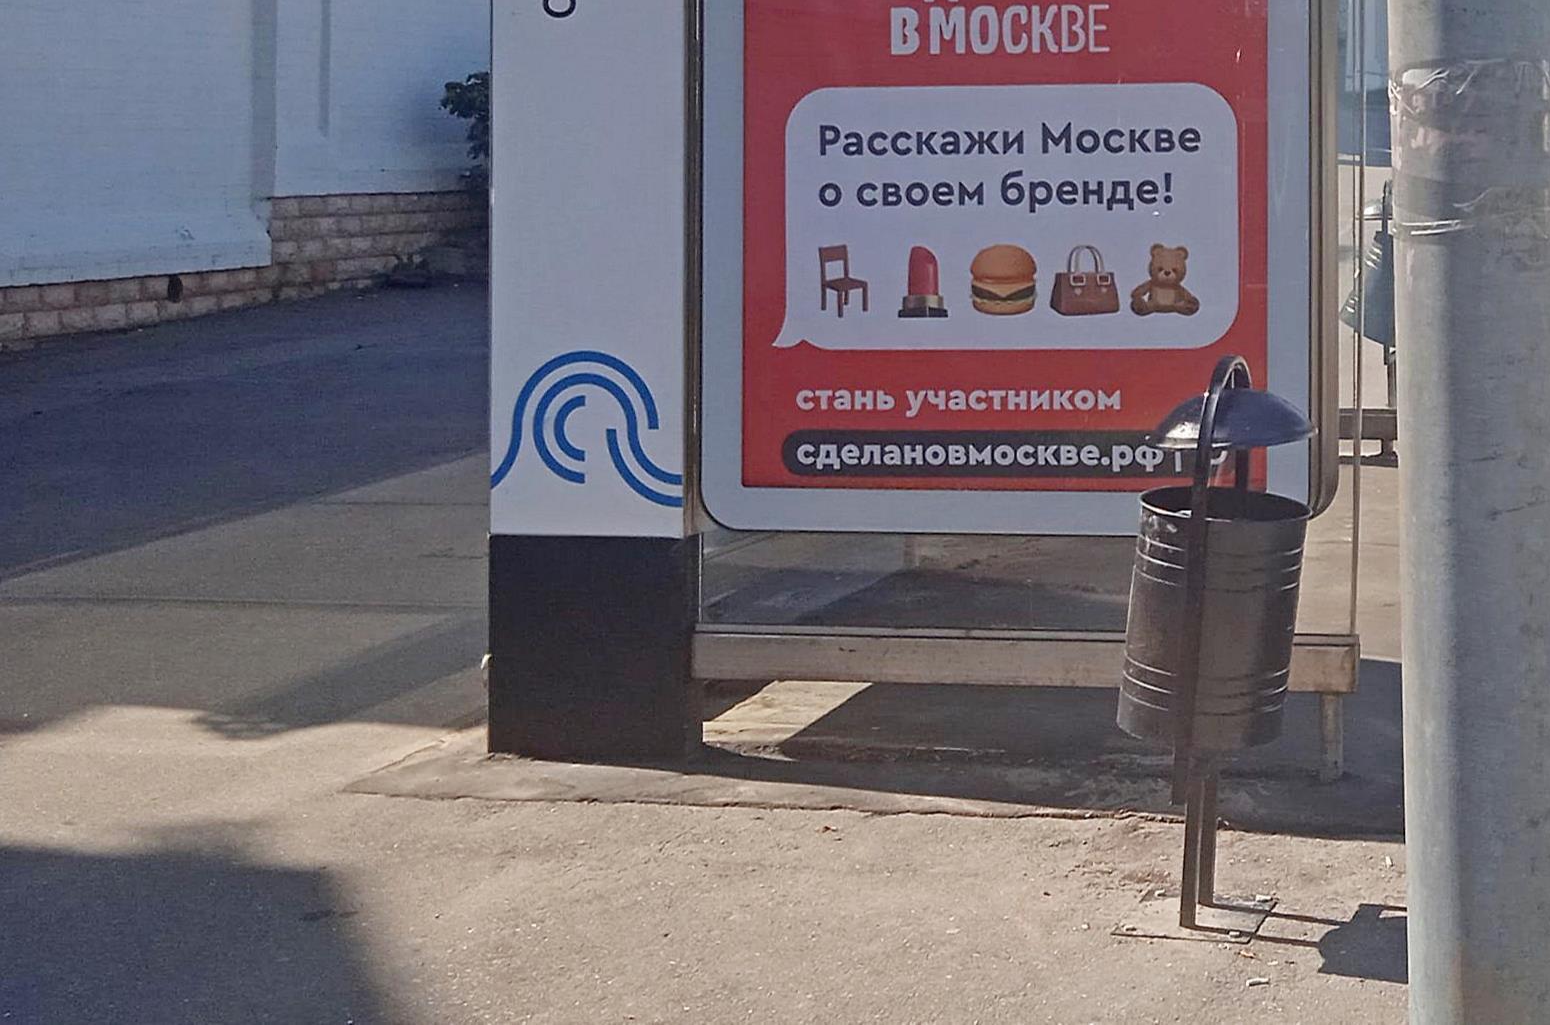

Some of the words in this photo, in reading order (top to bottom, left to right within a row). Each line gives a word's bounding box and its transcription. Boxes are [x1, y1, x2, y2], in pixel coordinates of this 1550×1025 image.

[890, 8, 919, 55] В
[929, 4, 1110, 54] МОСКВЕ
[818, 124, 1026, 158] Расскажи
[1041, 121, 1202, 155] Москве
[818, 181, 843, 207] о
[856, 180, 986, 207] своем
[1000, 171, 1174, 213] бренде!
[795, 390, 896, 412] стань
[905, 388, 1122, 417] участником
[795, 443, 1164, 473] сделановмоскве.рф
